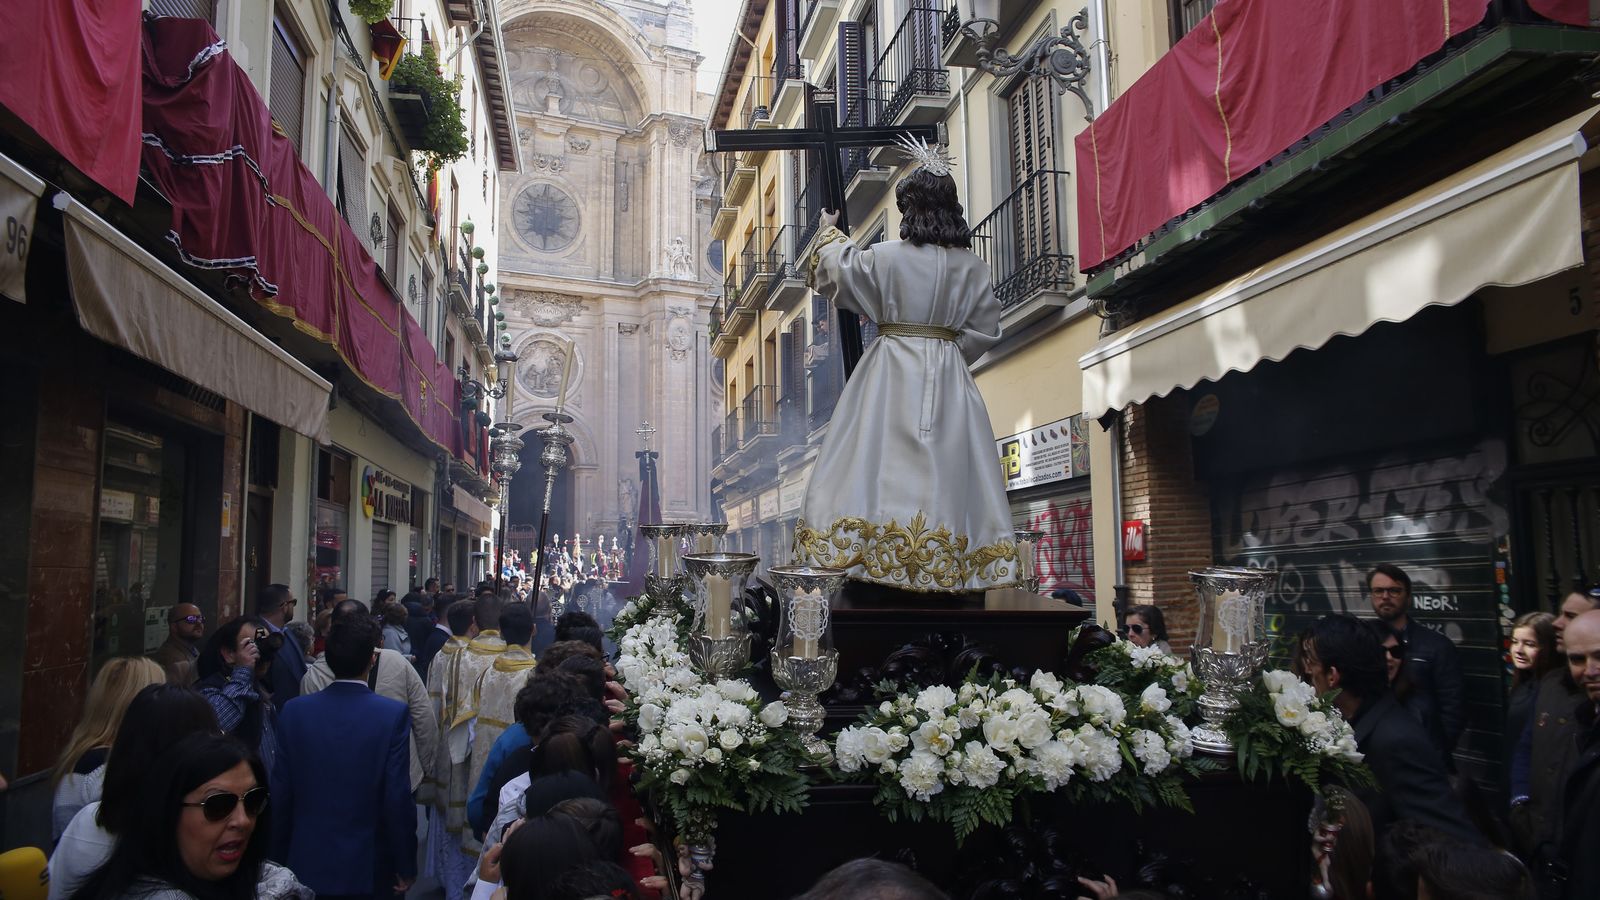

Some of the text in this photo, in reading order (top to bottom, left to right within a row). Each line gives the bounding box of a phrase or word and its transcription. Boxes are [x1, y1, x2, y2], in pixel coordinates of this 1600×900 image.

[7, 215, 27, 261] 96
[1569, 286, 1582, 316] 5
[1413, 595, 1459, 611] NEOR!
